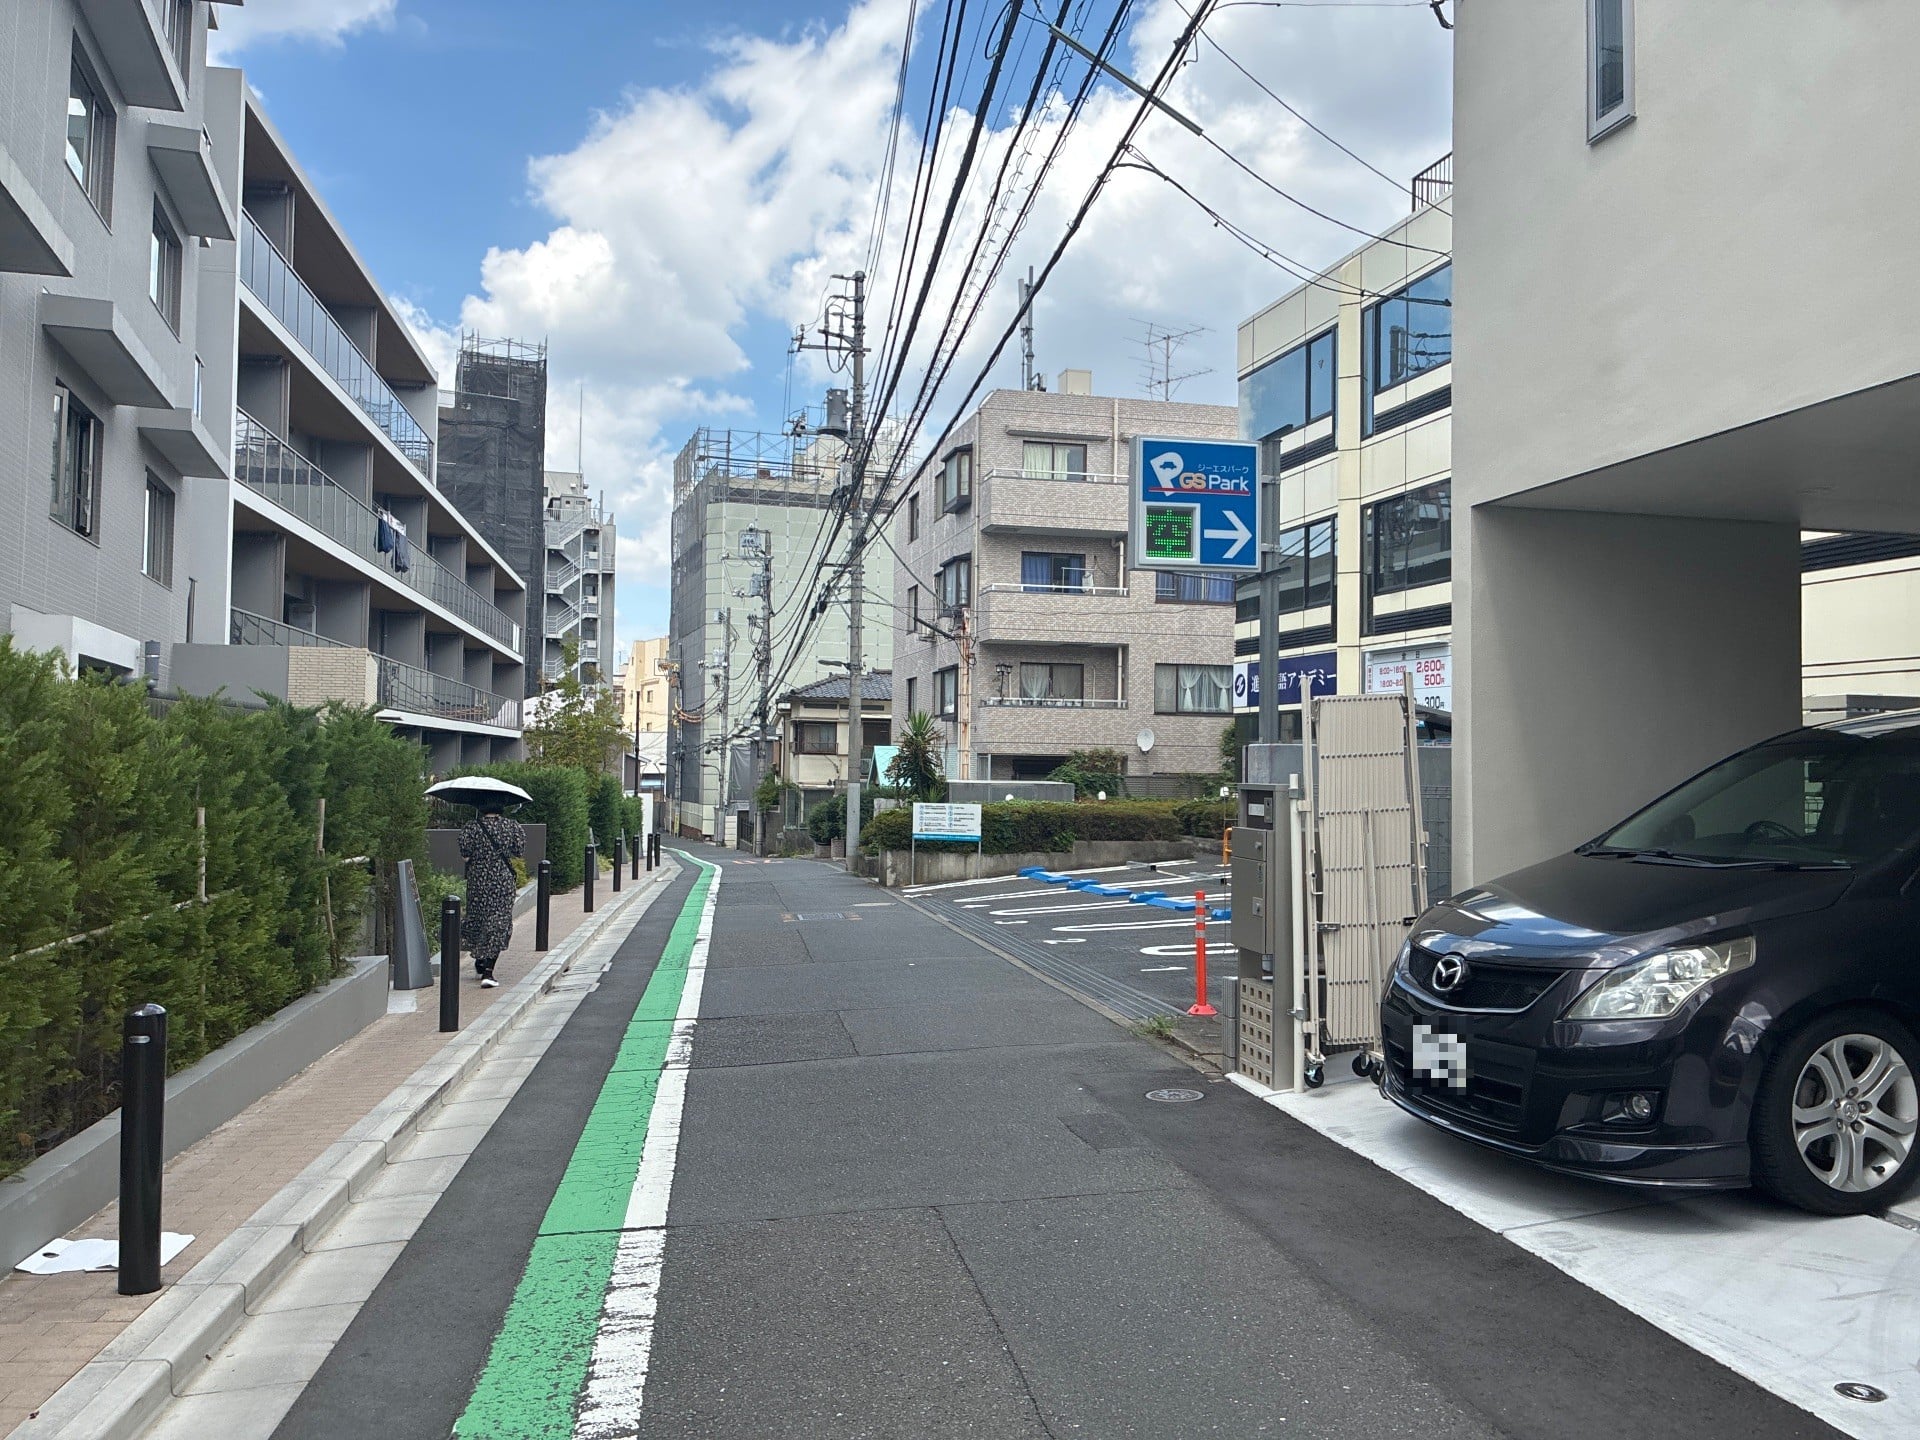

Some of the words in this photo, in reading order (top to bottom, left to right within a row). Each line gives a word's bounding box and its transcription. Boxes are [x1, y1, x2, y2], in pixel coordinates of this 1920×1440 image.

[1197, 464, 1249, 473] ジーエスパーク
[1179, 472, 1206, 490] GS
[1208, 474, 1250, 492] Park
[1146, 509, 1192, 558] 空
